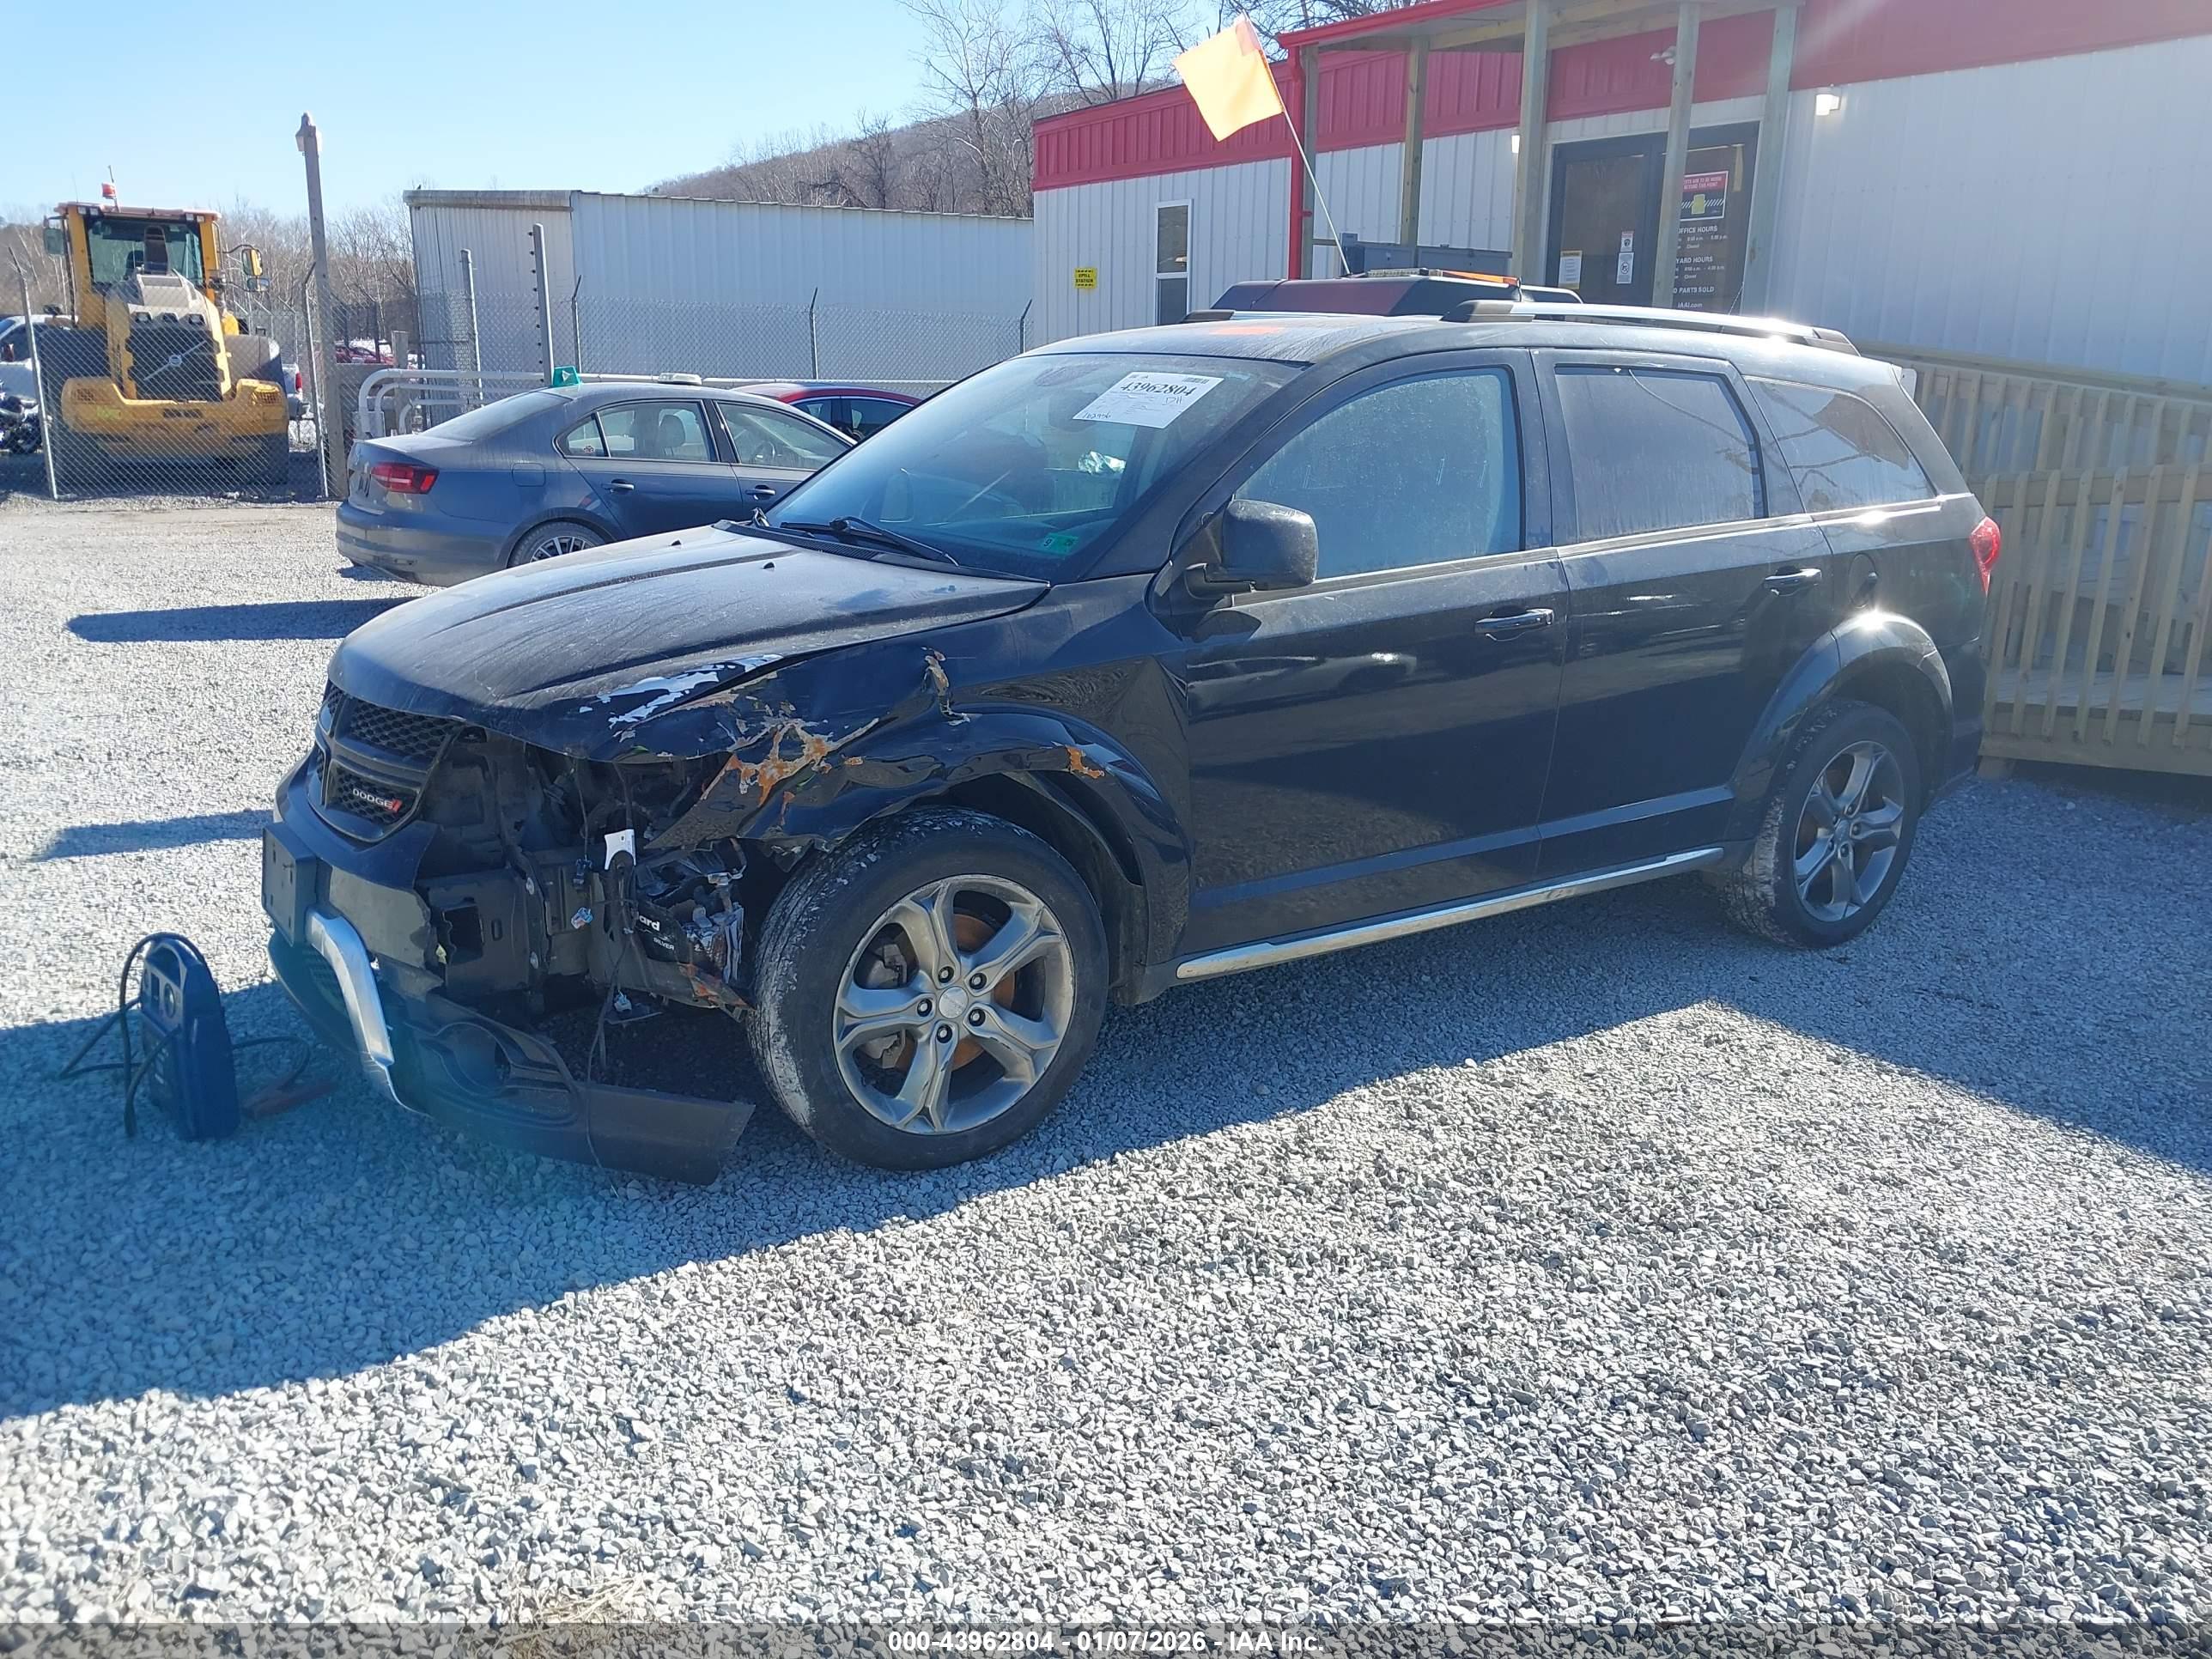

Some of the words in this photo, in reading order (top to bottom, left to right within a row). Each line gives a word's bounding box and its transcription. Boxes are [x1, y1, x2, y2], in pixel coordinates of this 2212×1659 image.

[1120, 382, 1197, 396] 43962804
[352, 788, 393, 809] DODGE
[639, 915, 660, 932] ard
[653, 937, 675, 950] SILVER
